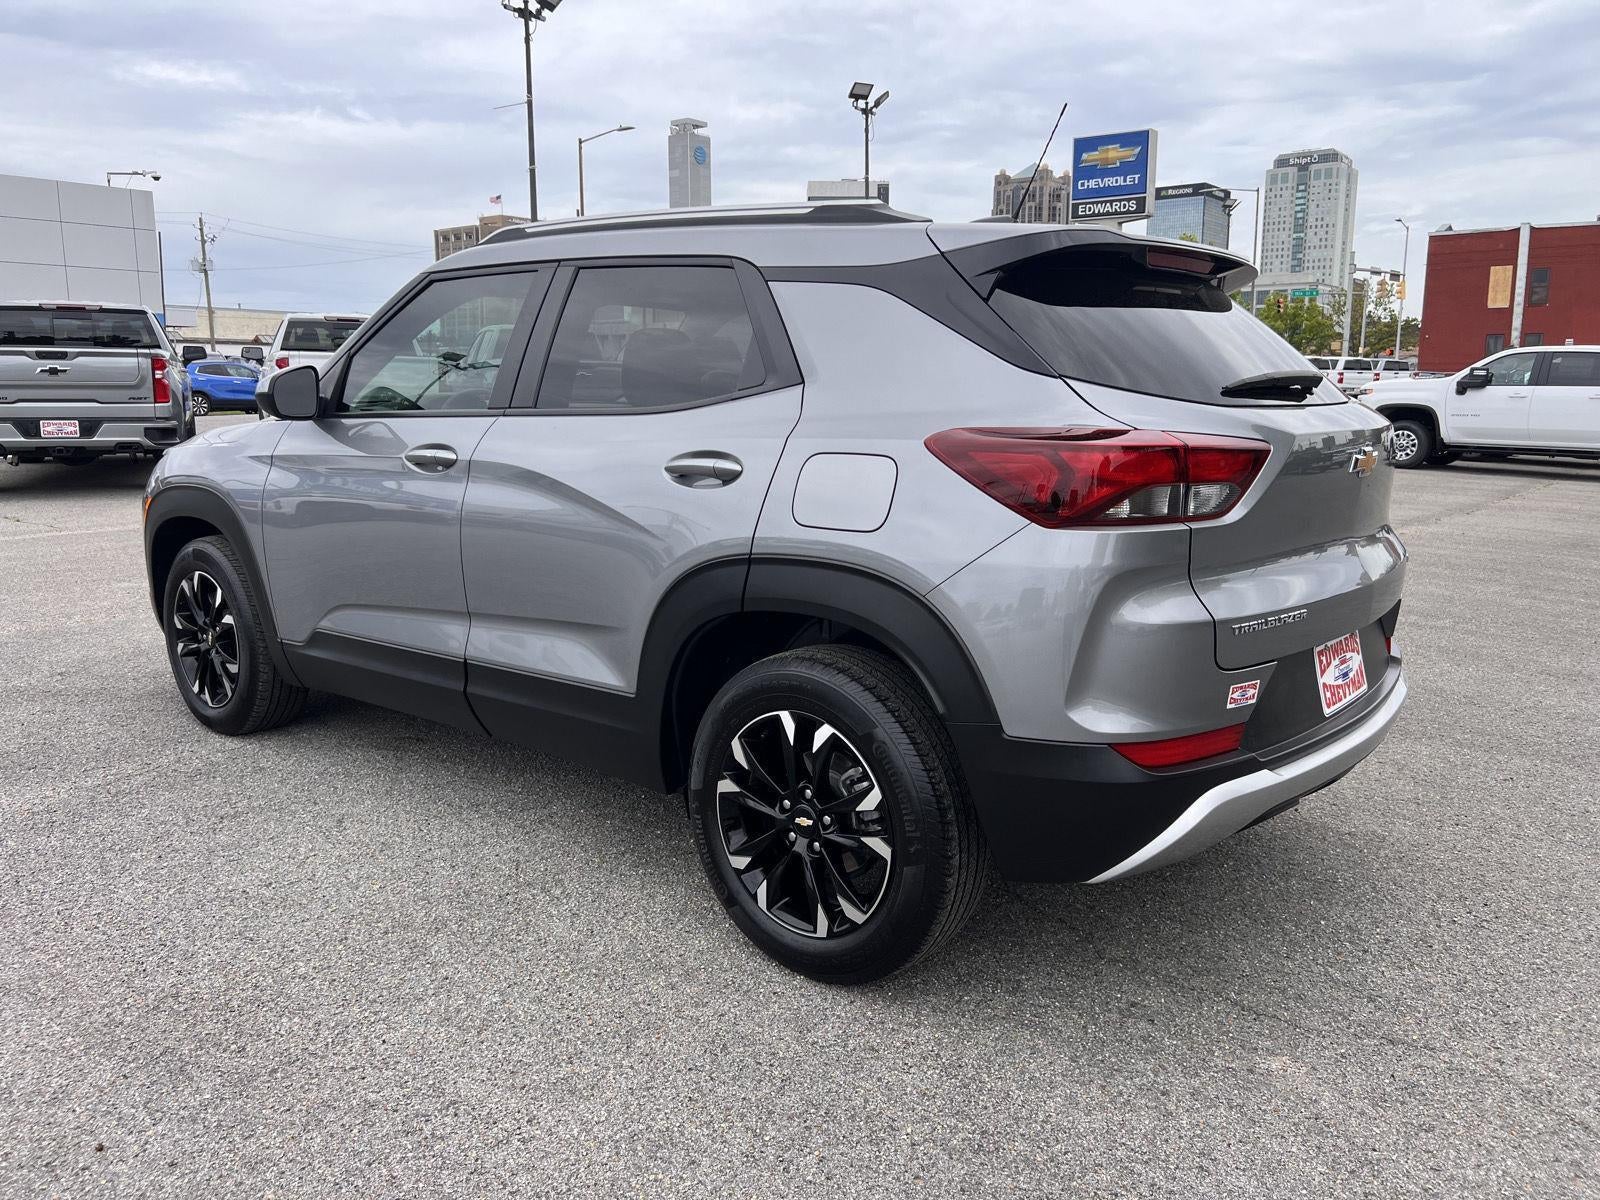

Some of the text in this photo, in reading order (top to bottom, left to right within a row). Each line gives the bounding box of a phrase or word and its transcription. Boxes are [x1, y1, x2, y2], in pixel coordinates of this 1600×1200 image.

[1289, 156, 1311, 165] Shipt
[1078, 174, 1140, 190] CHEVROLET
[1078, 200, 1137, 215] EDWARDS
[42, 421, 78, 429] EDWARDS
[42, 429, 78, 437] CHEVYMAN
[1232, 609, 1308, 635] TRAILBLAZER
[1317, 633, 1360, 679] EDWARDS
[1322, 661, 1366, 709] CHEVYMAN
